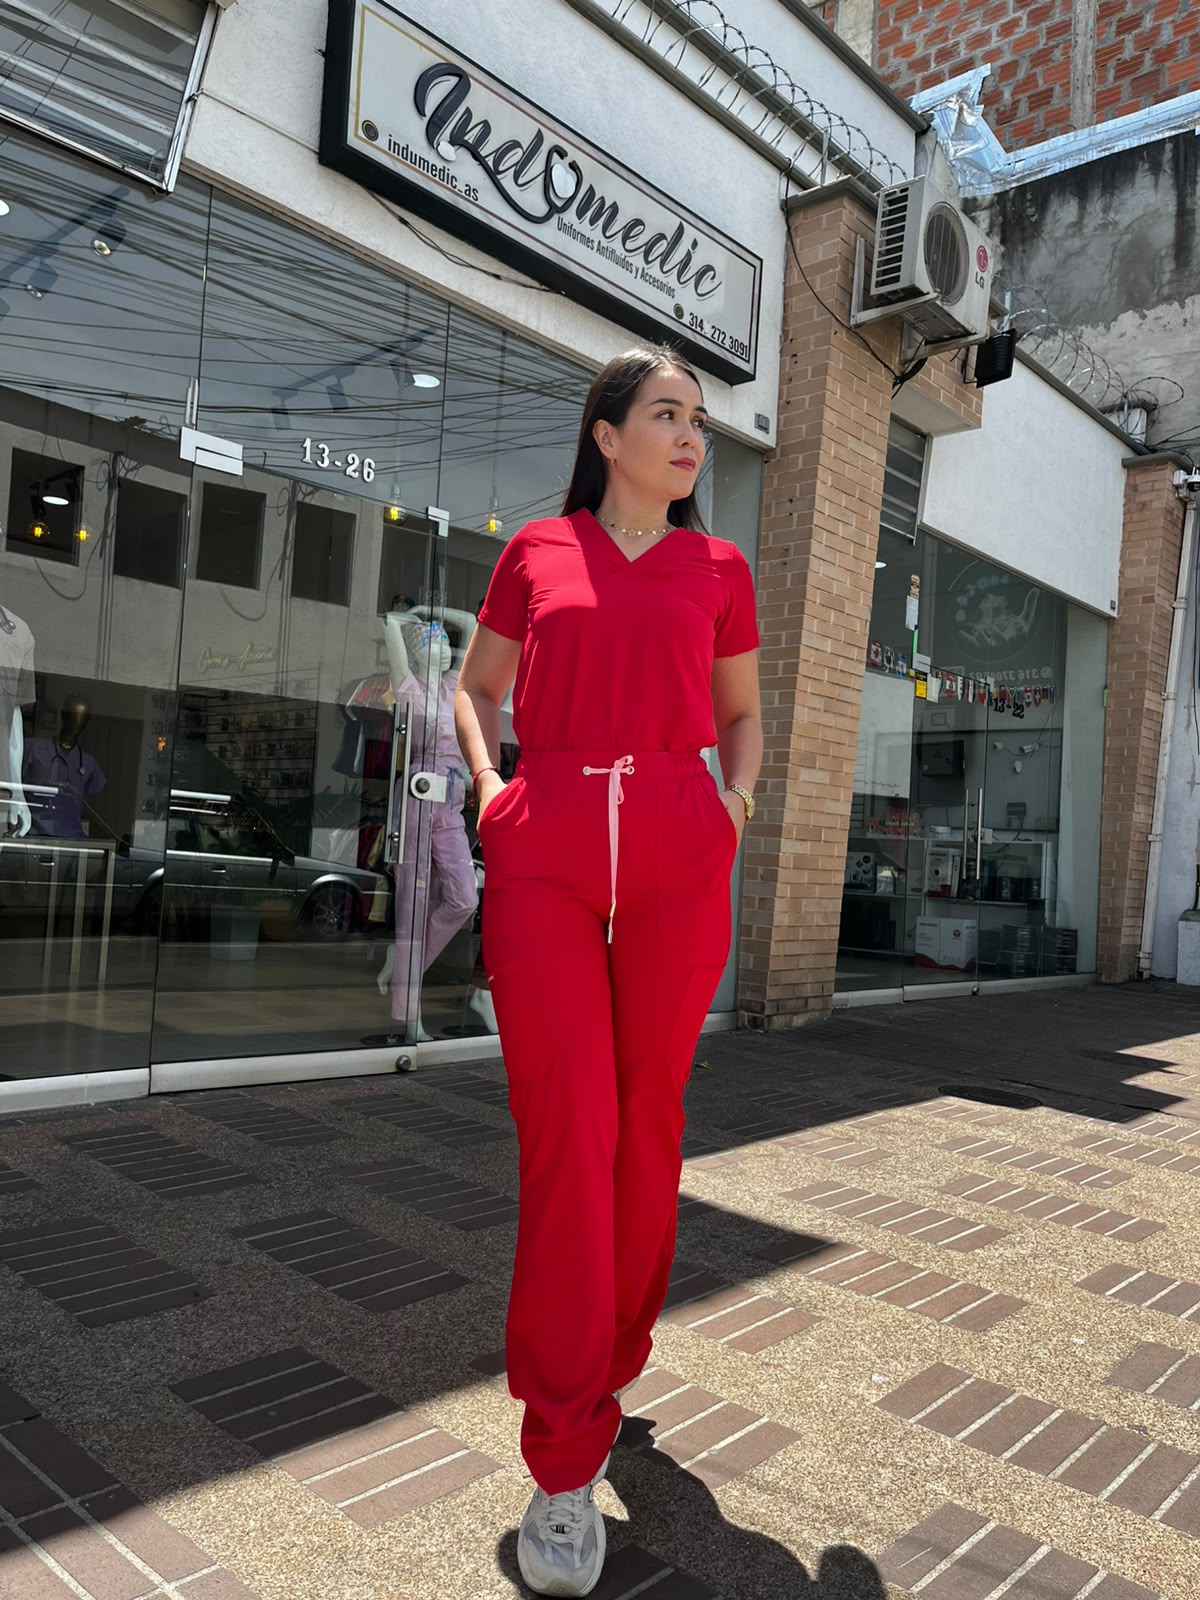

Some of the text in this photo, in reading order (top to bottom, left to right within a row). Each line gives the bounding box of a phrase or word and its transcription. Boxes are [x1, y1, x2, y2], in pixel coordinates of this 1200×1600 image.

[388, 133, 479, 202] indumedic_as
[556, 215, 676, 299] Uniformes Antifluidos y Accesorios
[975, 271, 985, 290] LG
[710, 324, 727, 346] 272
[728, 335, 749, 359] 3091
[302, 437, 376, 483] 13-26
